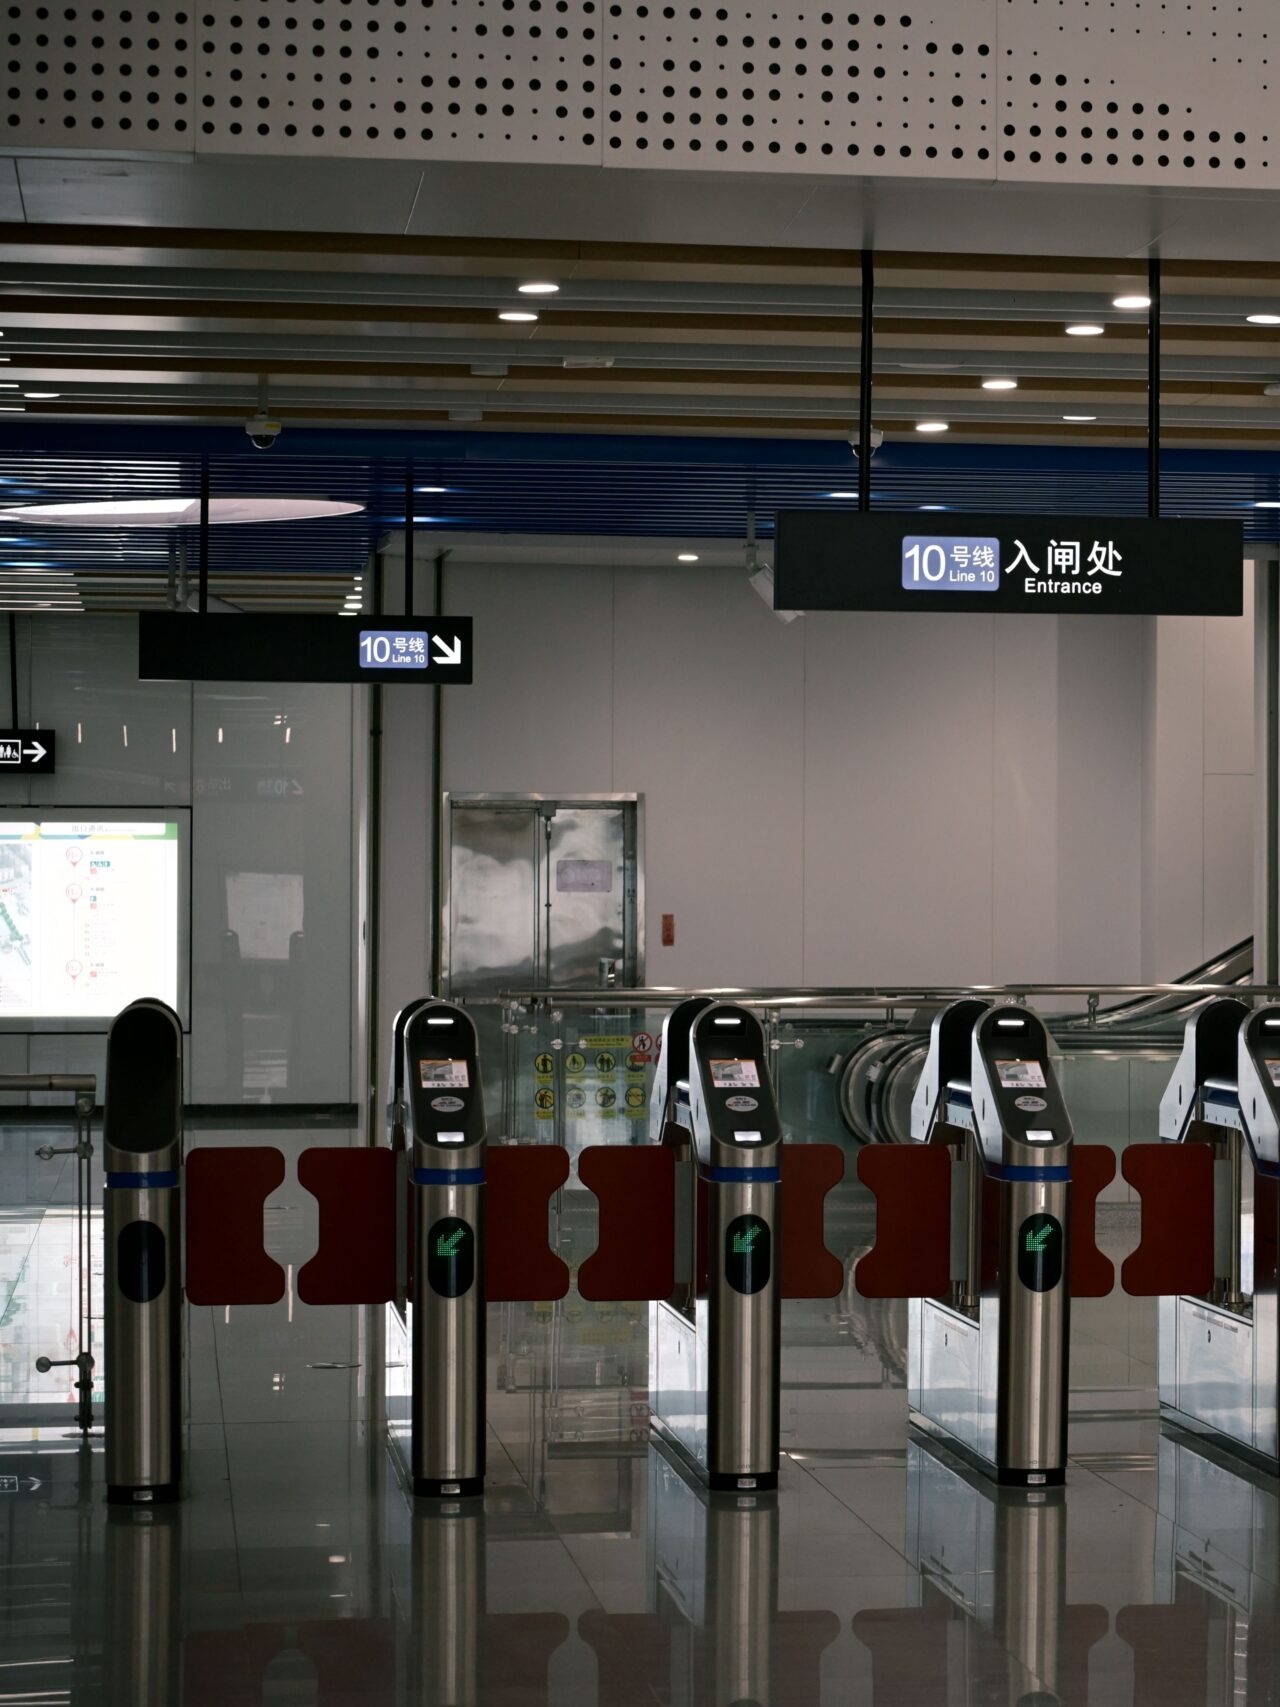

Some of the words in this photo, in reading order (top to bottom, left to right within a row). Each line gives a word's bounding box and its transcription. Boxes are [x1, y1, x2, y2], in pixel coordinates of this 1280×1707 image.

[1004, 539, 1123, 577] 入闸处
[949, 569, 976, 582] Line
[980, 570, 995, 583] 10
[1024, 577, 1103, 595] Entrance
[392, 654, 412, 663] Line
[414, 654, 425, 664] 10
